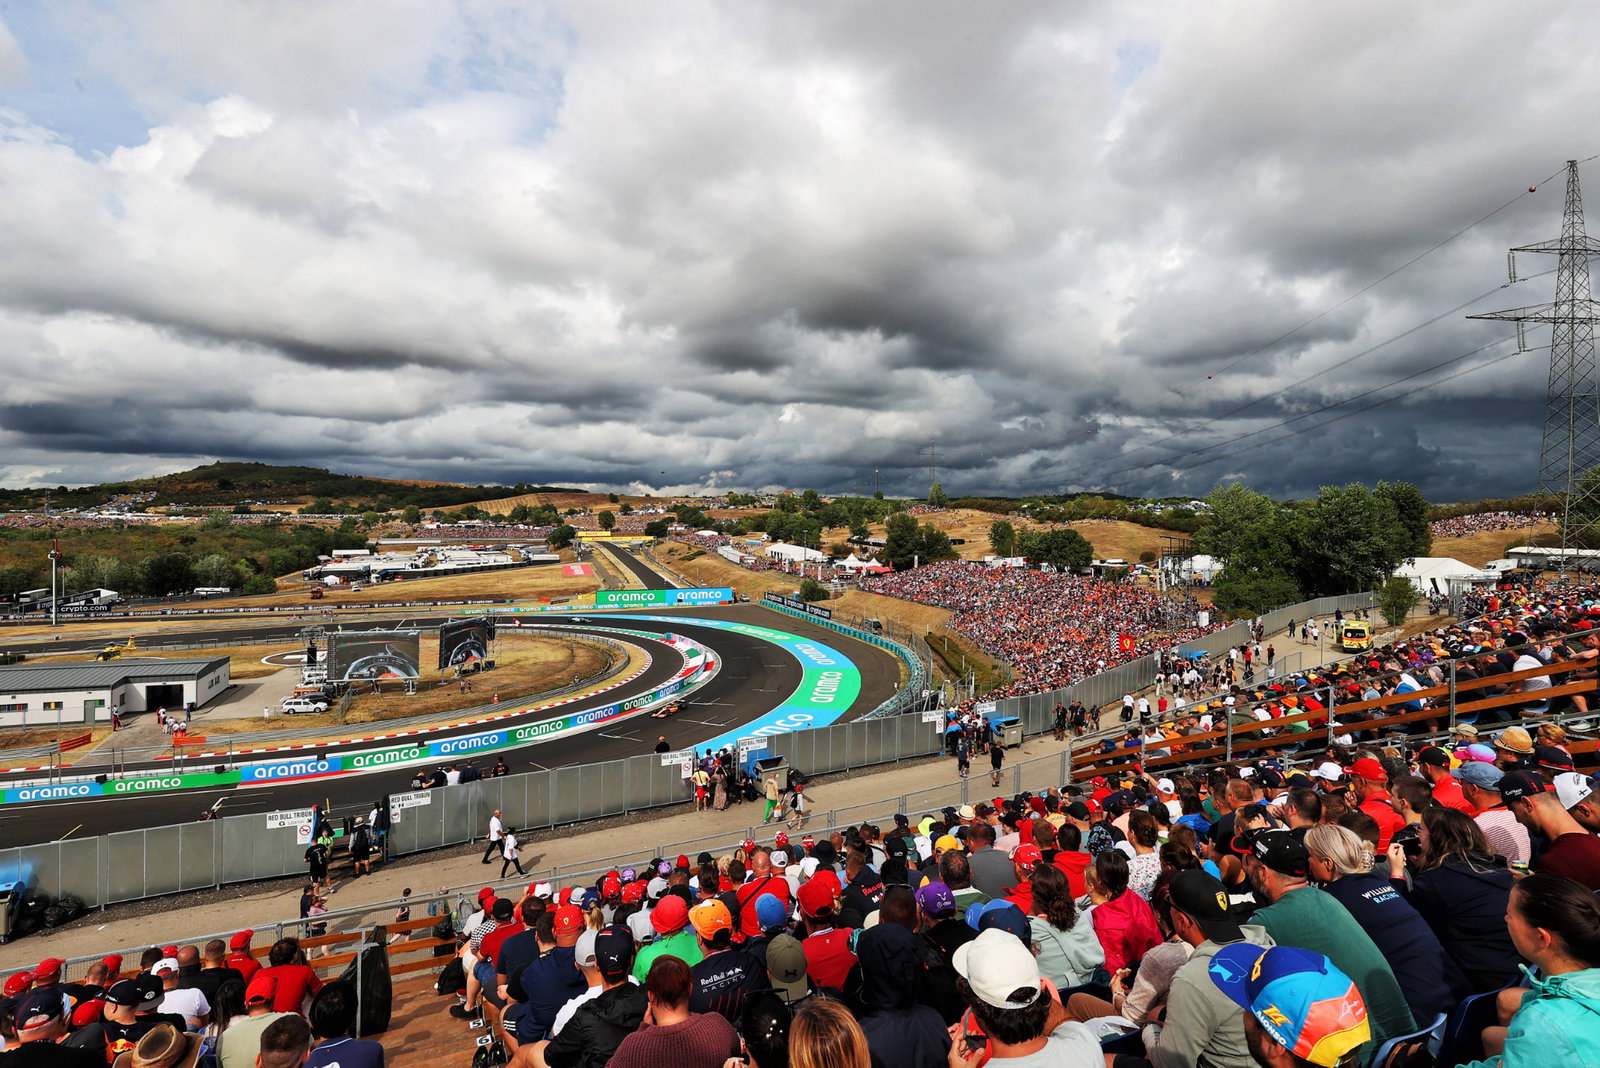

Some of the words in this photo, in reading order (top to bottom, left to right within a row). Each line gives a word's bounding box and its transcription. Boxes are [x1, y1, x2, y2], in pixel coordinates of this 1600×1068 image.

[608, 592, 655, 602] aramco
[677, 590, 722, 600] aramco
[60, 605, 108, 613] crypto.com
[809, 606, 830, 618] crypto.com
[660, 683, 680, 697] aramco
[809, 671, 843, 703] aramco
[624, 694, 653, 711] aramco
[577, 706, 614, 724] aramco
[515, 720, 563, 739] aramco
[440, 734, 499, 753] aramco
[353, 748, 420, 767] aramco
[254, 760, 329, 779] aramco
[18, 785, 90, 800] aramco
[115, 777, 182, 792] aramco
[401, 794, 413, 802] BULL
[702, 974, 746, 993] RACING
[1255, 1010, 1288, 1046] ALONSO
